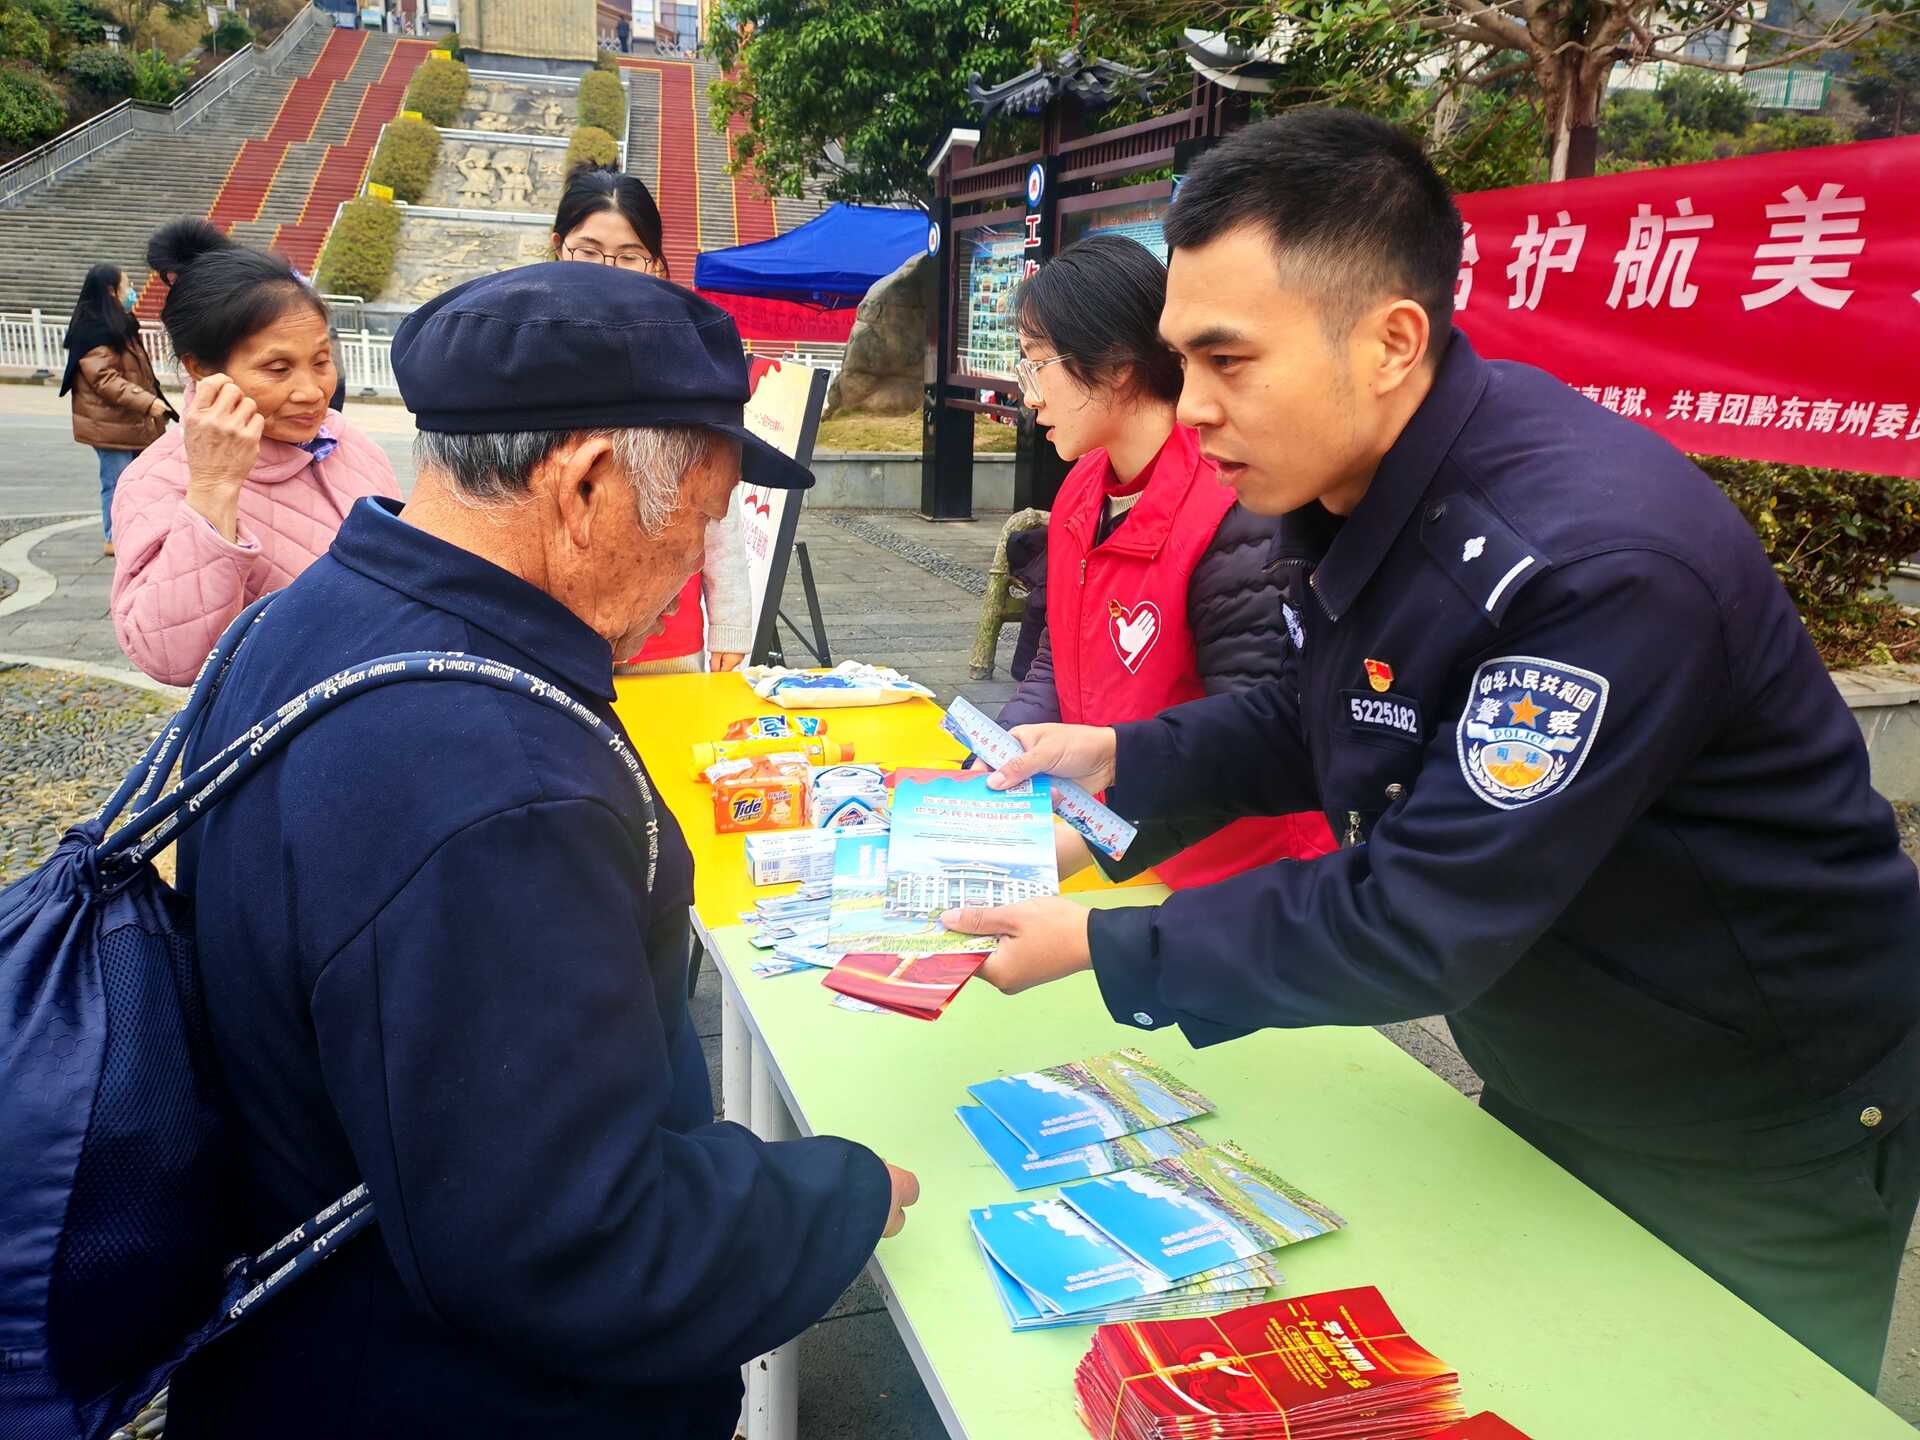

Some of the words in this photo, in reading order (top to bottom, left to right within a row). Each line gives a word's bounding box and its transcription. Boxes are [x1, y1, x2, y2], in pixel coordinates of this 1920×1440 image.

[1568, 384, 1920, 440] 监狱、共青团黔东南州委
[337, 670, 366, 689] UNDER
[367, 661, 406, 678] ARMOUR
[445, 660, 476, 673] UNDER
[478, 663, 514, 682] ARMOUR
[545, 687, 572, 707] UNDER
[570, 699, 601, 728] ARMOUR
[1480, 668, 1597, 712] 中华人民共和国
[1351, 698, 1417, 733] 5225182
[1493, 729, 1550, 747] POLICE
[619, 746, 640, 774] UNDER
[634, 771, 653, 804] ARMOUR
[733, 797, 763, 819] Tide
